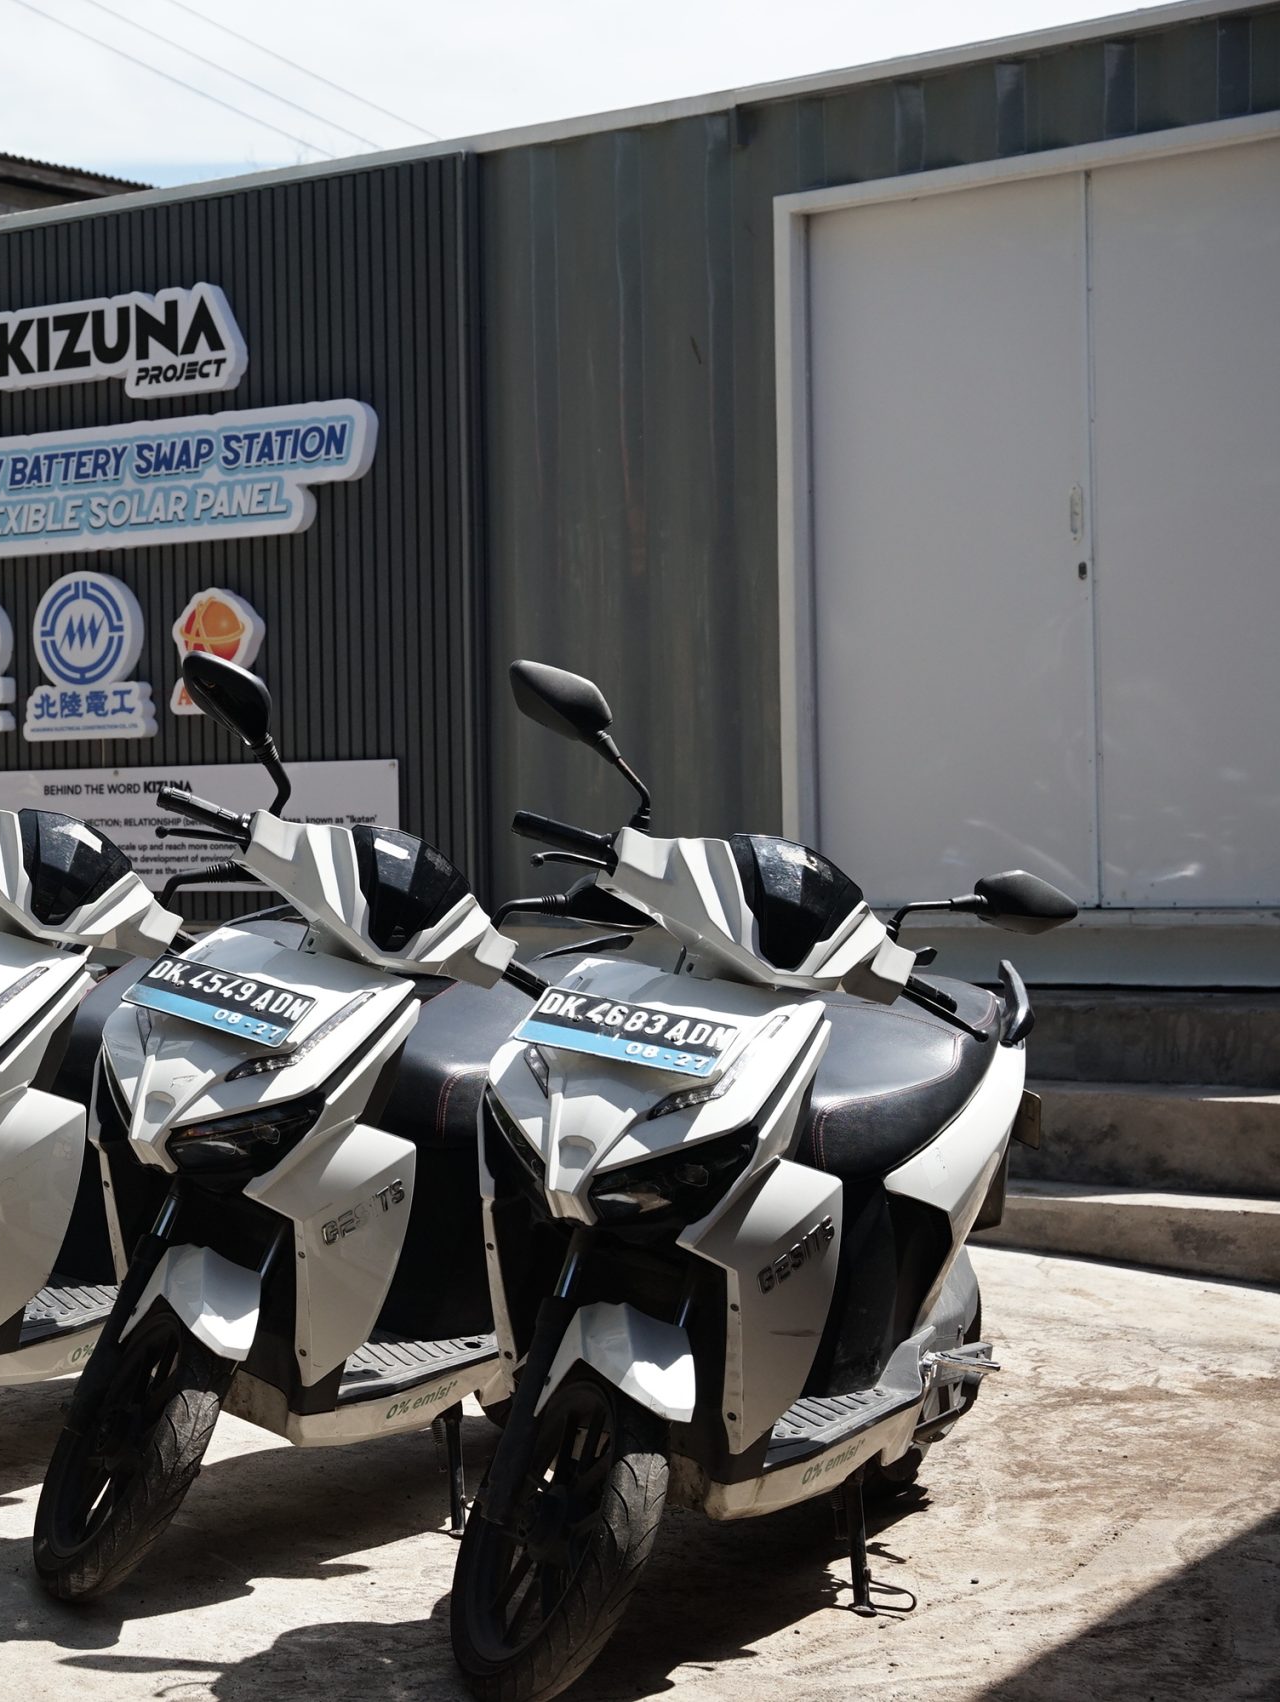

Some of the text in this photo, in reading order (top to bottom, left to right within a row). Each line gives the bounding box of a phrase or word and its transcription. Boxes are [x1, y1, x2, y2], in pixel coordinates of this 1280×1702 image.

[134, 357, 228, 387] PROJECT
[8, 445, 129, 488] BATTERY
[134, 437, 215, 477] SWAP
[221, 423, 348, 470] STATION
[88, 489, 189, 530] SOLAR
[193, 480, 288, 519] PANEL
[33, 688, 136, 720] 北陸電工
[43, 784, 82, 796] BEHIND
[84, 783, 105, 795] THE
[107, 782, 141, 795] WORD
[124, 816, 181, 828] RELATIONSHIP
[306, 815, 333, 825] known
[335, 816, 344, 824] as
[138, 844, 148, 852] up
[150, 842, 163, 851] and
[165, 841, 186, 851] reach
[188, 843, 208, 851] more
[140, 854, 188, 865] development
[190, 854, 200, 863] of
[155, 867, 163, 875] as
[165, 865, 177, 875] the
[147, 960, 311, 1022] DK 4549 ADN
[537, 992, 741, 1051] DK 4683 ADN
[321, 1178, 405, 1246] GETS
[756, 1214, 835, 1295] GESITS
[386, 1398, 412, 1419] 0%
[802, 1460, 824, 1485] 0%
